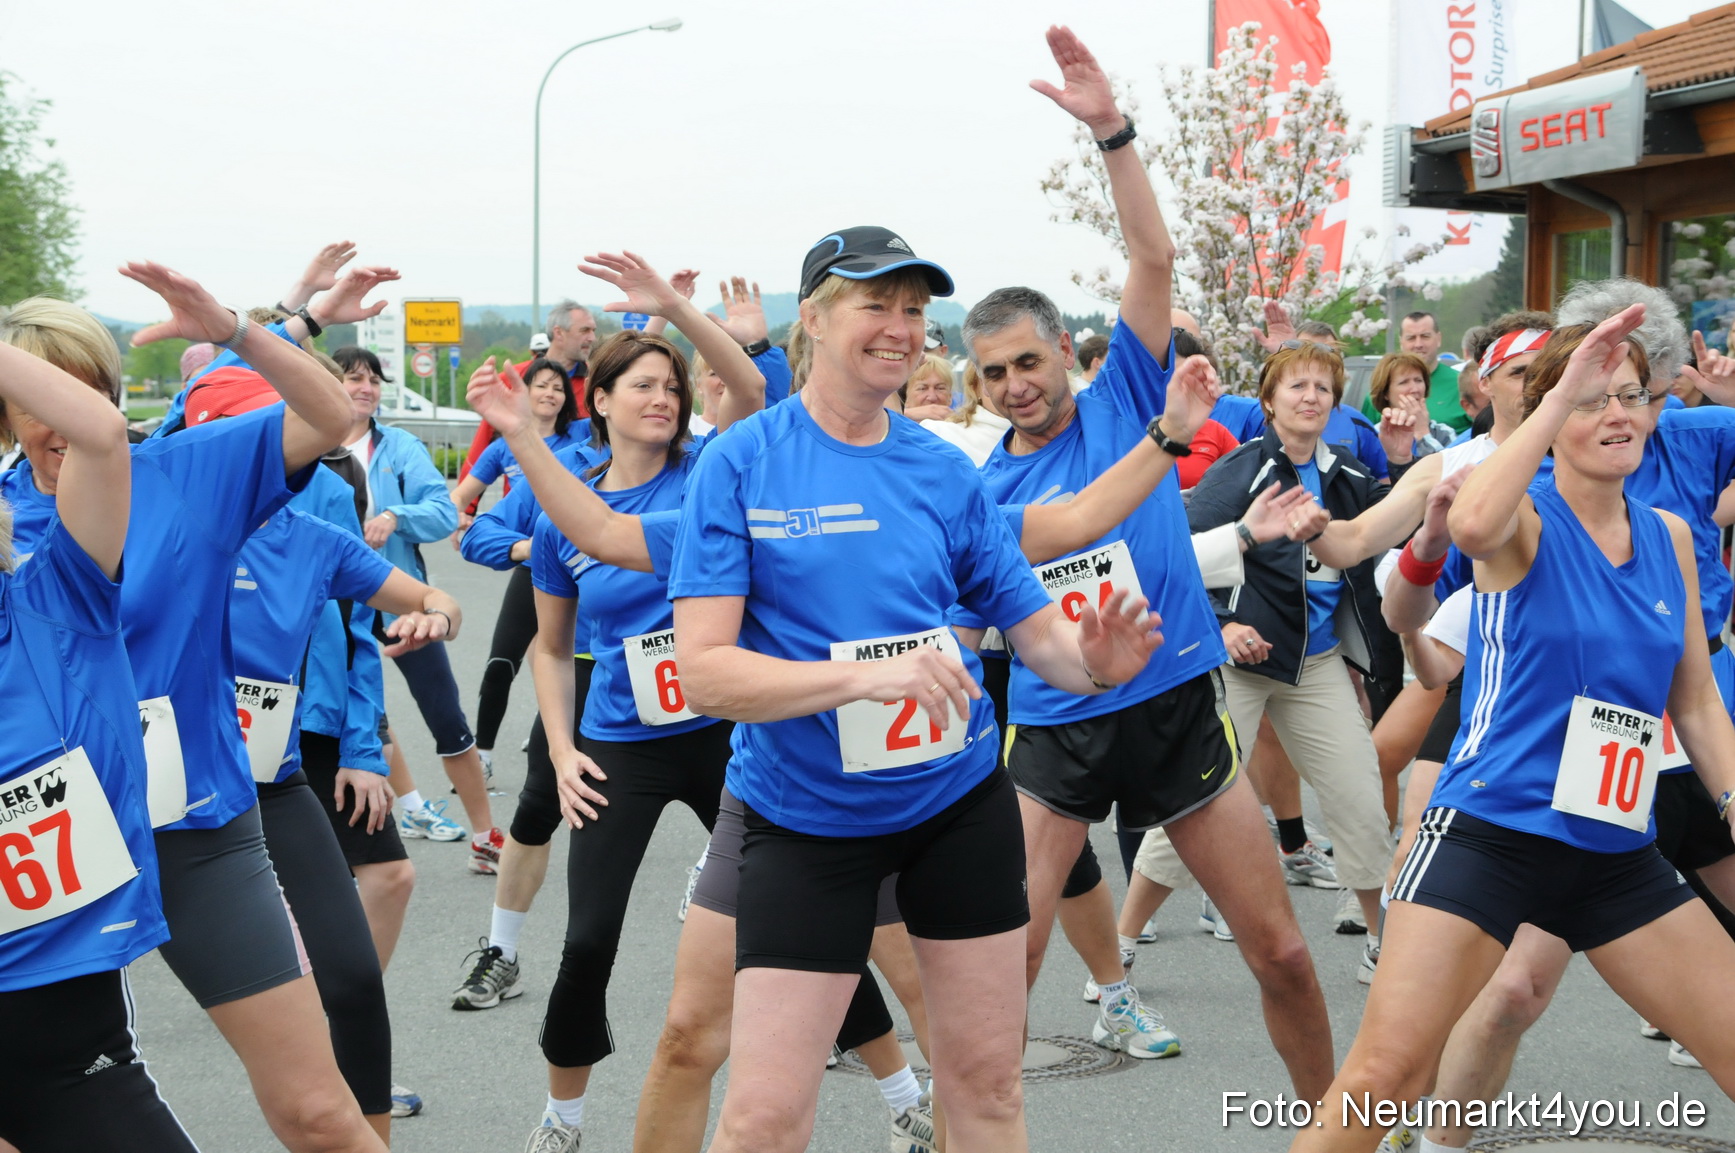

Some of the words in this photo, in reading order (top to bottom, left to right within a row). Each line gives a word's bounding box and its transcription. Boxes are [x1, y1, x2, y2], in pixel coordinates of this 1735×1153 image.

[1447, 0, 1475, 112] OTOR
[1520, 102, 1613, 153] SEAT
[410, 316, 456, 327] Neumarkt
[1042, 558, 1090, 582] MEYER
[1044, 569, 1093, 590] WERBUNG
[641, 633, 674, 650] MEY
[643, 645, 674, 657] WERBU
[235, 682, 261, 698] YER
[655, 660, 686, 713] 6
[236, 696, 259, 706] UNG
[1590, 719, 1639, 741] WERBUNG
[1591, 706, 1641, 731] MEYER
[1597, 740, 1645, 813] 10
[0, 785, 33, 811] ER
[0, 809, 82, 911] 67
